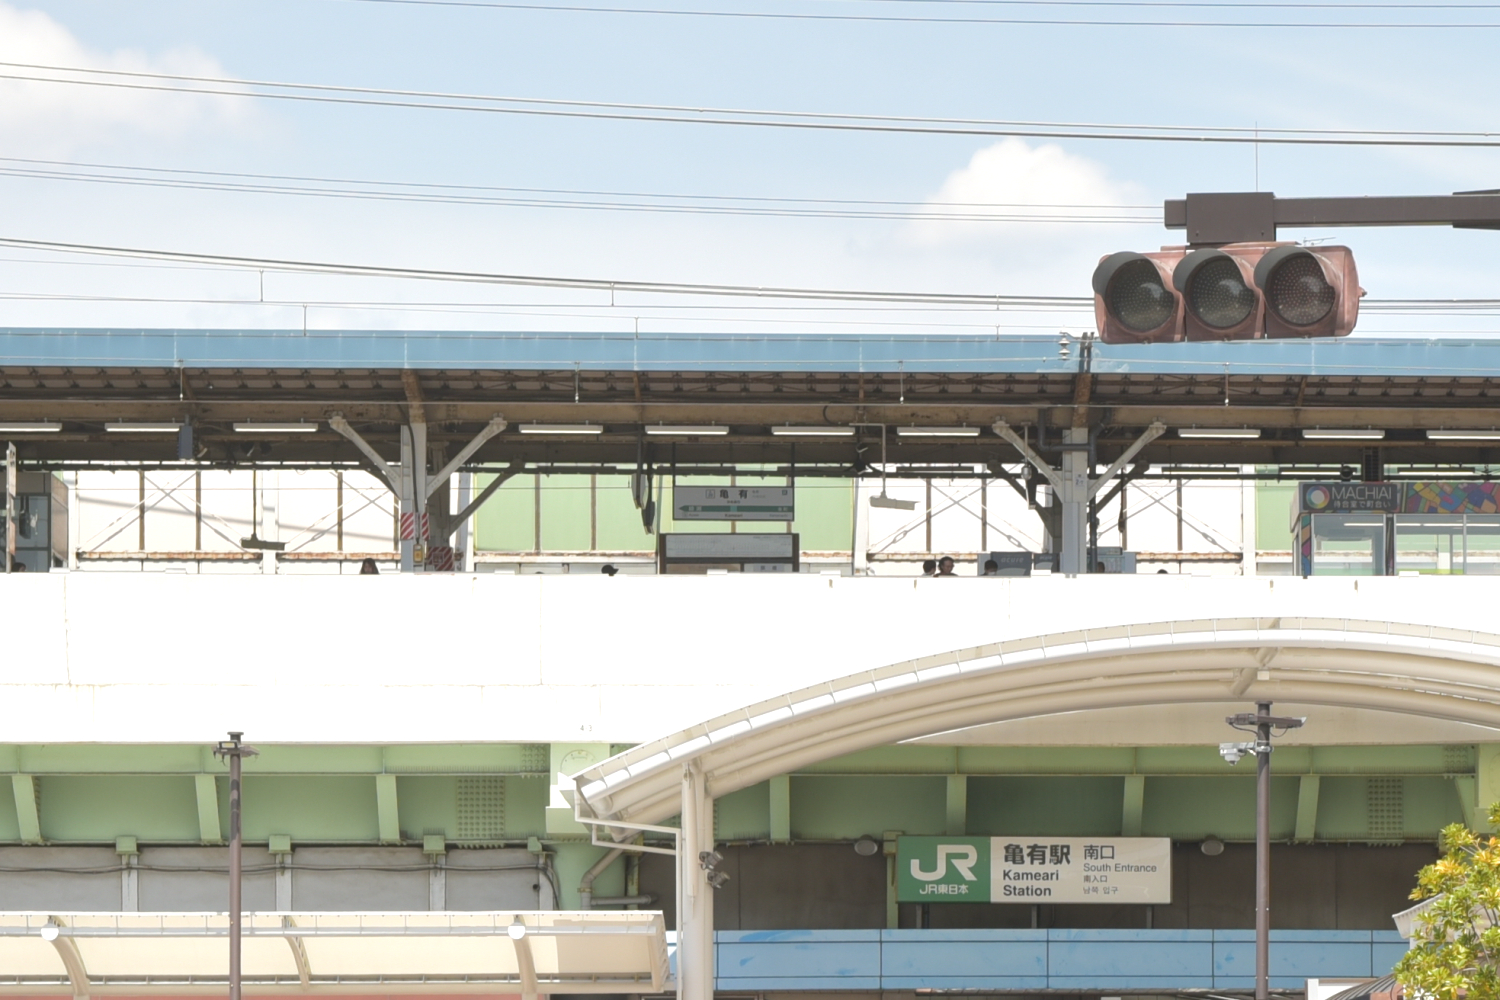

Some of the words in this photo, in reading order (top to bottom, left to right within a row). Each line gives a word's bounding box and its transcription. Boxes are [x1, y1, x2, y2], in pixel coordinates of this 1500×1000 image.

[1331, 486, 1392, 500] MACHIAI
[1003, 843, 1071, 866] 亀有駅
[1083, 845, 1115, 860] 南口
[910, 844, 978, 881] JR
[1083, 863, 1111, 873] South
[1114, 863, 1157, 873] Entrance
[1003, 869, 1060, 882] Kameari
[919, 884, 969, 895] JR東日本
[1003, 885, 1052, 897] Station
